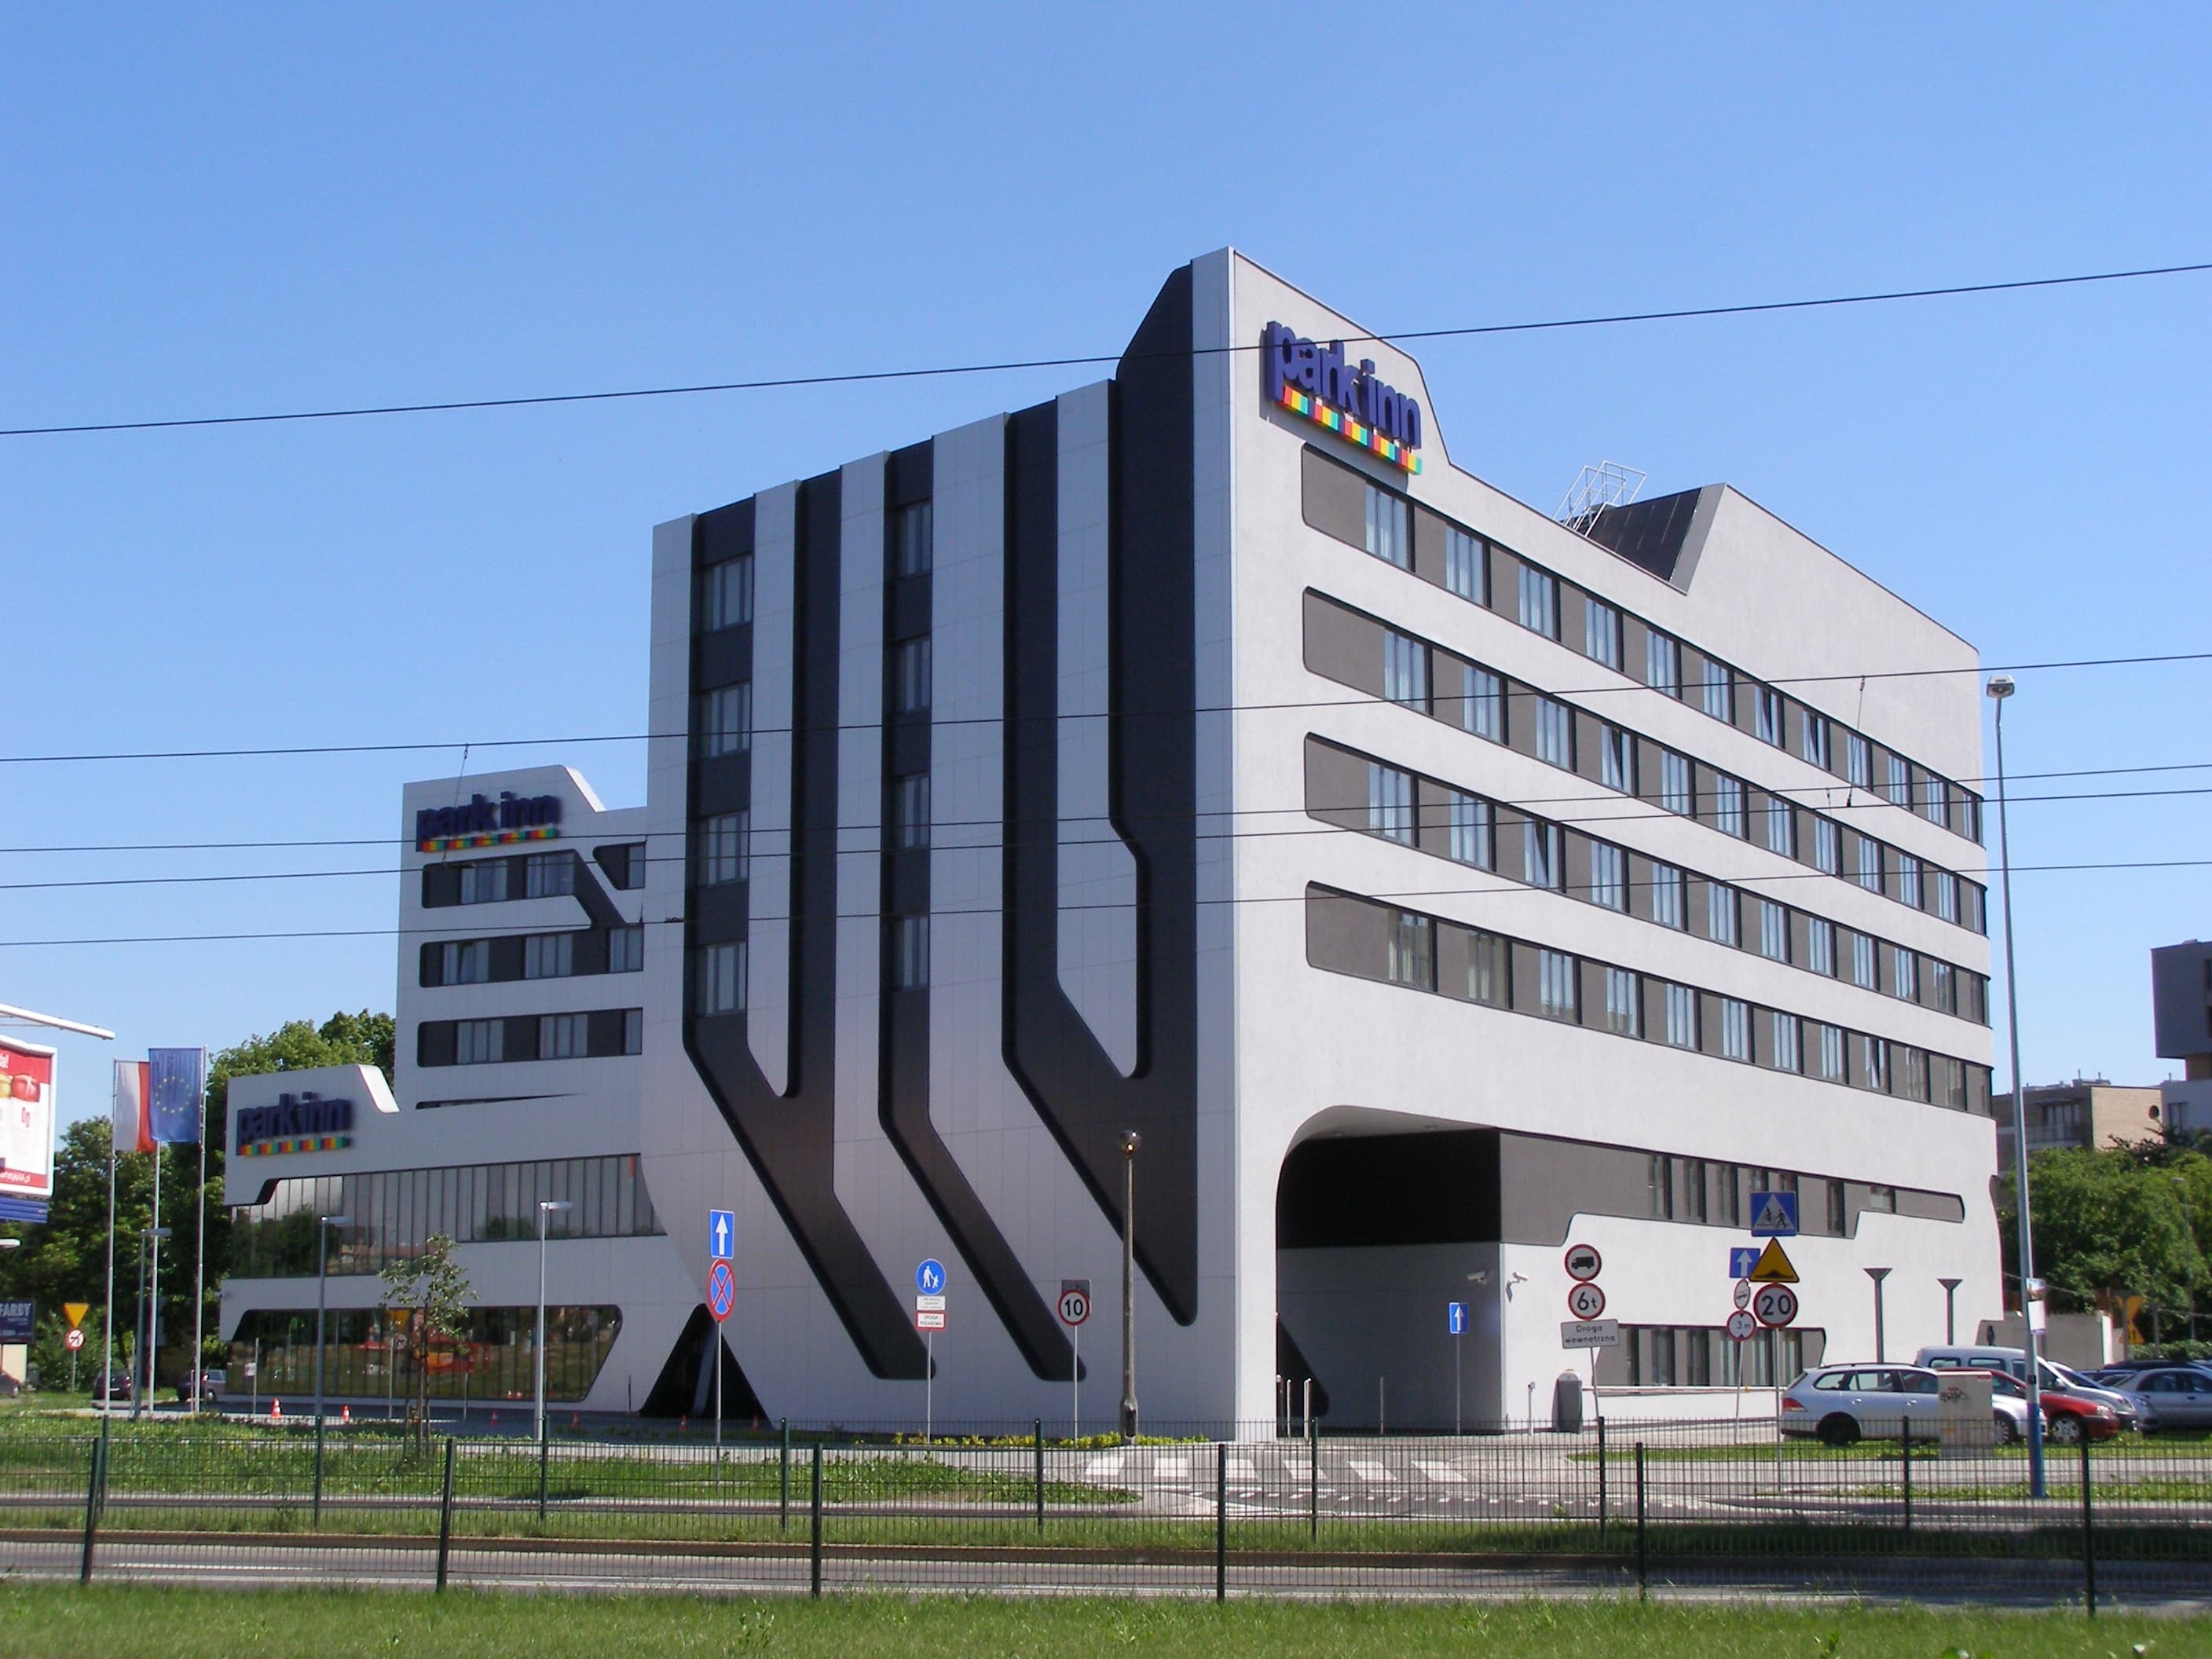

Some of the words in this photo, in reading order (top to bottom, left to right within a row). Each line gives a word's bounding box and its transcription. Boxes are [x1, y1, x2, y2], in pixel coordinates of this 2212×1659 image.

[1264, 320, 1361, 416] park
[1361, 358, 1421, 449] inn
[416, 793, 499, 851] park
[500, 791, 559, 829] inn
[236, 1093, 300, 1155] park
[301, 1092, 353, 1132] inn
[1064, 1298, 1083, 1317] 10
[1761, 1295, 1793, 1316] 20
[1576, 1324, 1603, 1334] Droga
